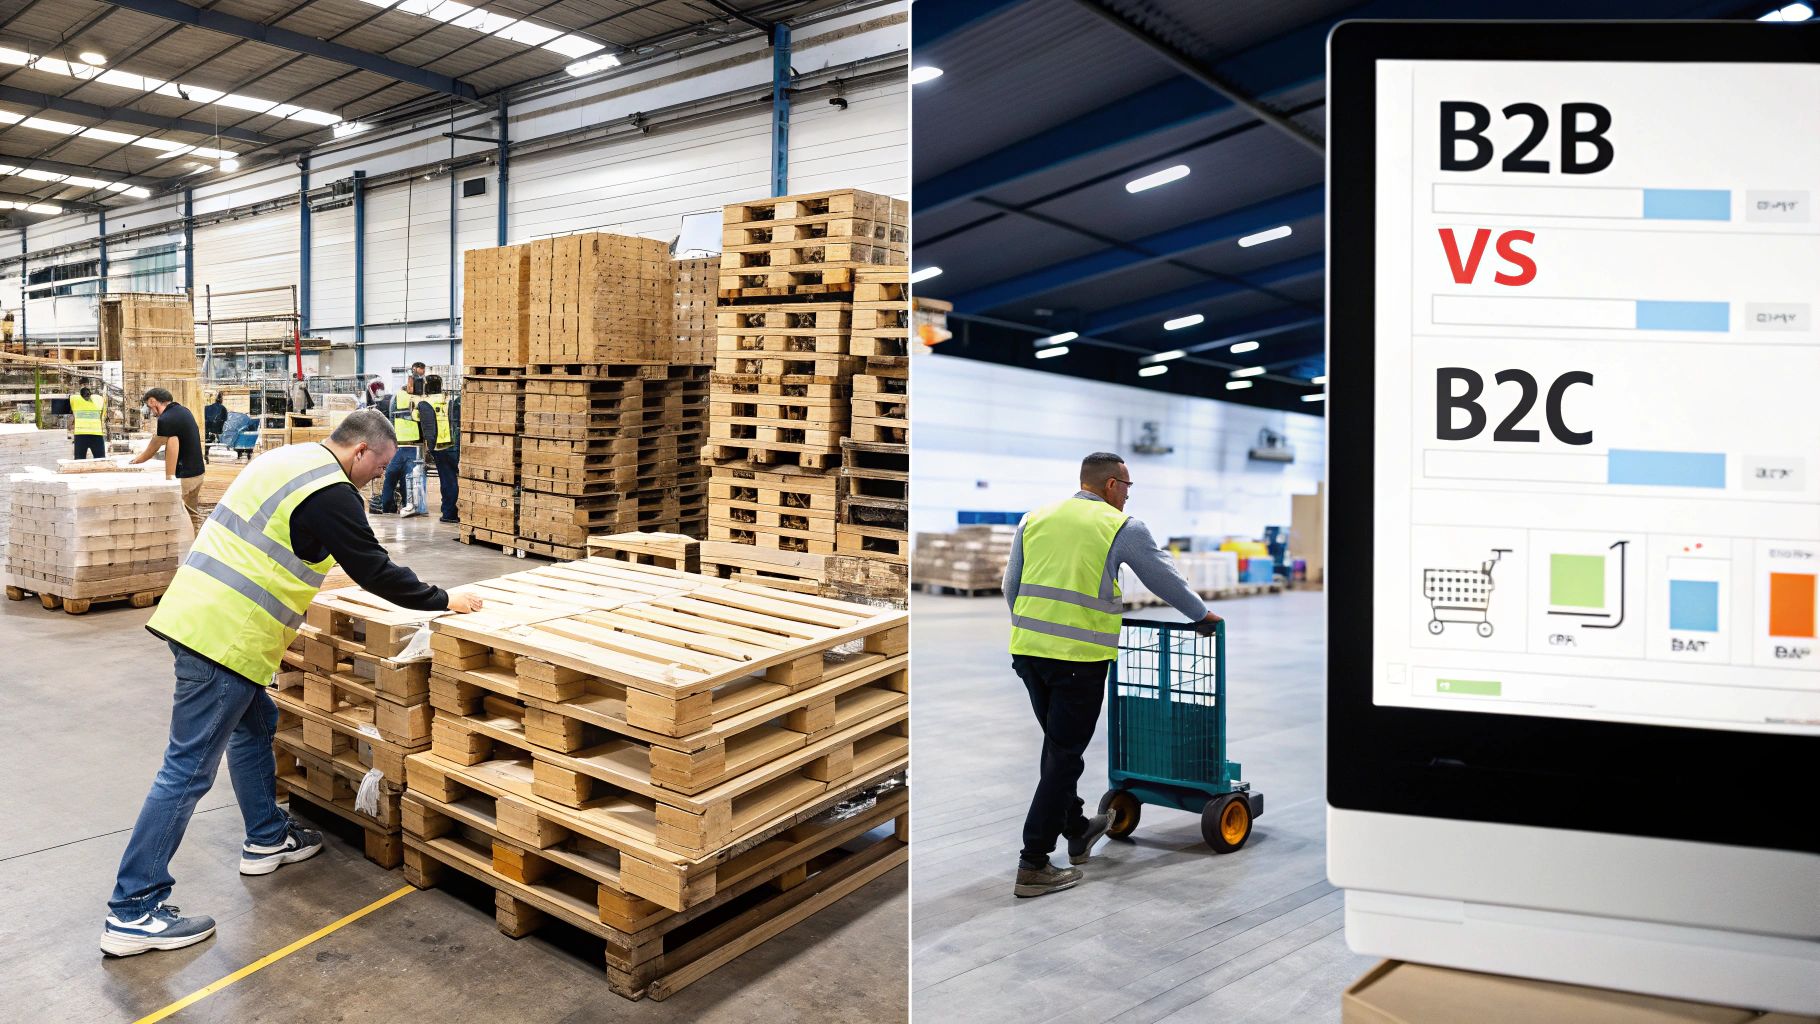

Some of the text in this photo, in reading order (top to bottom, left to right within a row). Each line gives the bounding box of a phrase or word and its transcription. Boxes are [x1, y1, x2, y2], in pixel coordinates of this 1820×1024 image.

[1439, 101, 1614, 174] B2B
[1438, 228, 1537, 286] VS
[1436, 367, 1594, 445] B2C
